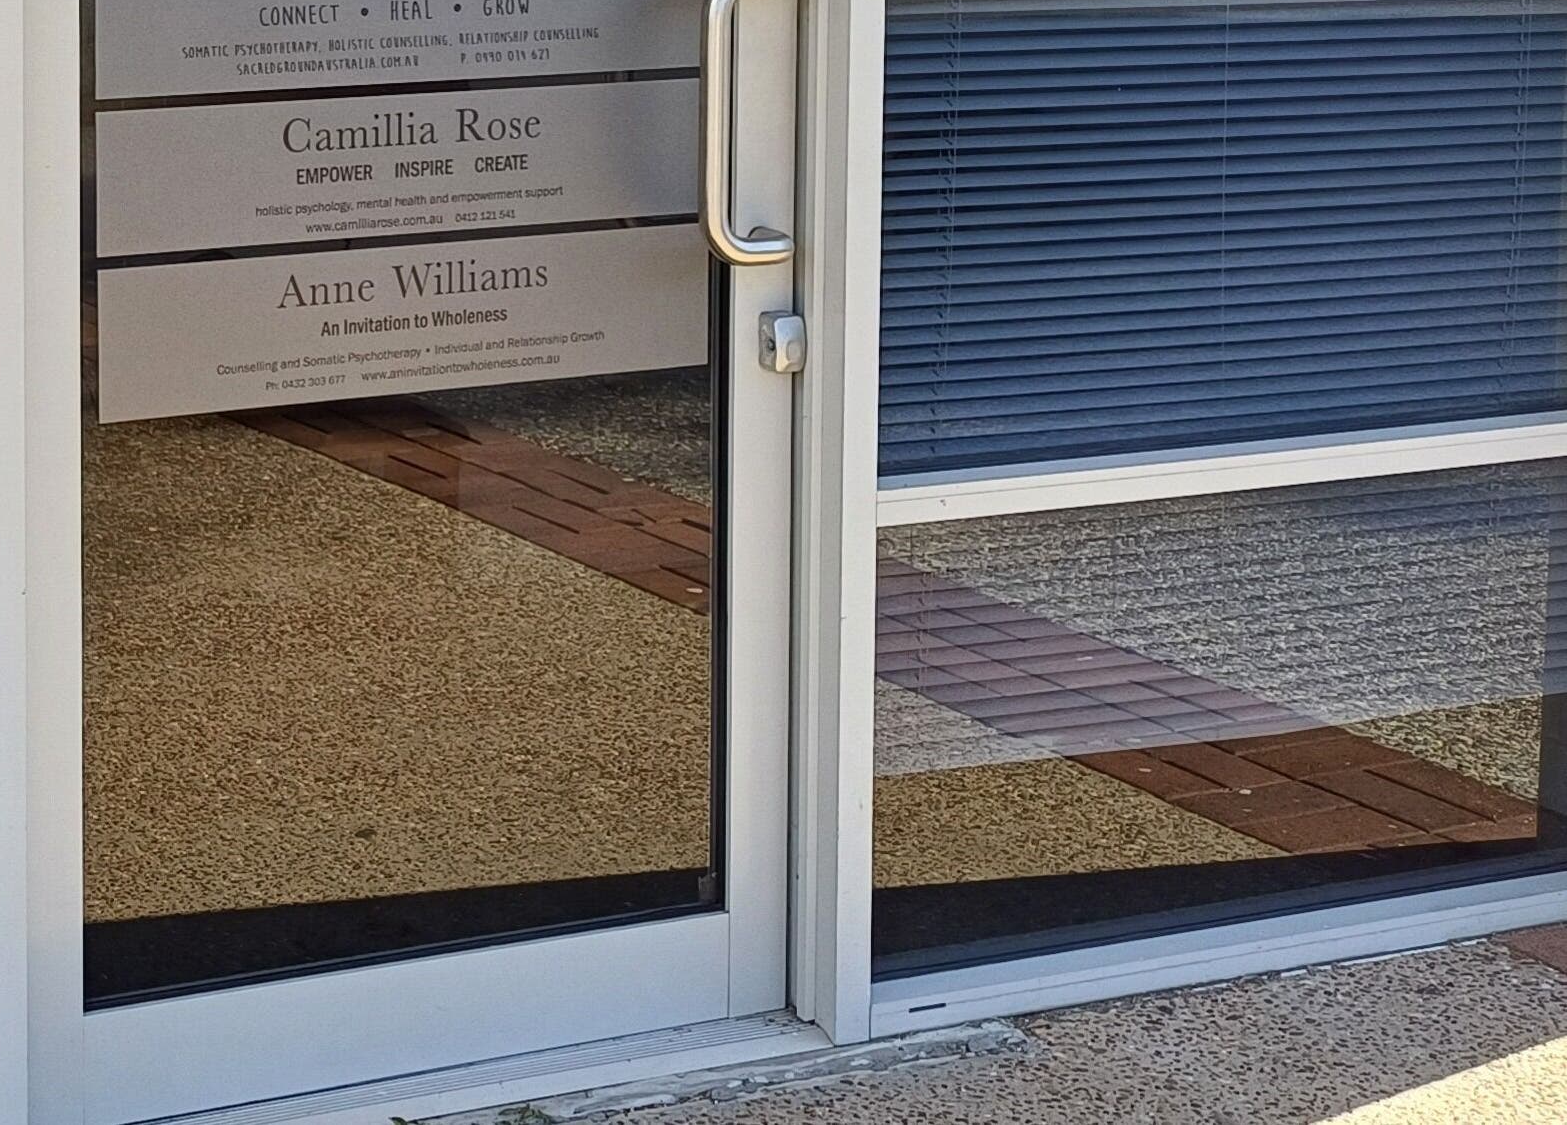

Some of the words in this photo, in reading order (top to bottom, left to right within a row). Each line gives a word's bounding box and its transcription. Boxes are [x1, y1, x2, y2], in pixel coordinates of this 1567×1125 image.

[259, 4, 340, 27] CONNECT
[390, 0, 433, 21] HEAL
[182, 44, 230, 59] SOMATIC
[328, 37, 375, 52] HOLISTIC
[459, 30, 529, 46] RELATIONSHIP
[534, 26, 600, 43] COUNSELLING
[282, 112, 439, 154] Camillia
[455, 107, 541, 143] Rose
[296, 164, 373, 185] EMPOWER
[395, 158, 454, 178] INSPIRE
[474, 153, 529, 173] CREATE
[255, 203, 292, 218] holistic
[295, 201, 354, 217] psychology,
[356, 196, 392, 210] mental
[394, 194, 427, 207] health
[429, 192, 449, 205] and
[451, 189, 523, 204] empowerment
[524, 185, 564, 200] support
[305, 213, 443, 234] www.camilliarose.com.au
[277, 274, 375, 308] Anne
[392, 259, 548, 299] Williams
[321, 321, 340, 338] An
[343, 314, 410, 335] Invitation
[413, 313, 428, 329] to
[432, 308, 508, 327] Wholeness
[217, 360, 278, 376] Counselling
[280, 357, 300, 370] and
[303, 354, 345, 368] Somatic
[348, 348, 422, 365] Psychotherapy
[434, 341, 483, 355] Individual
[485, 338, 504, 350] and
[507, 334, 568, 348] Relationship
[570, 330, 605, 343] Growth
